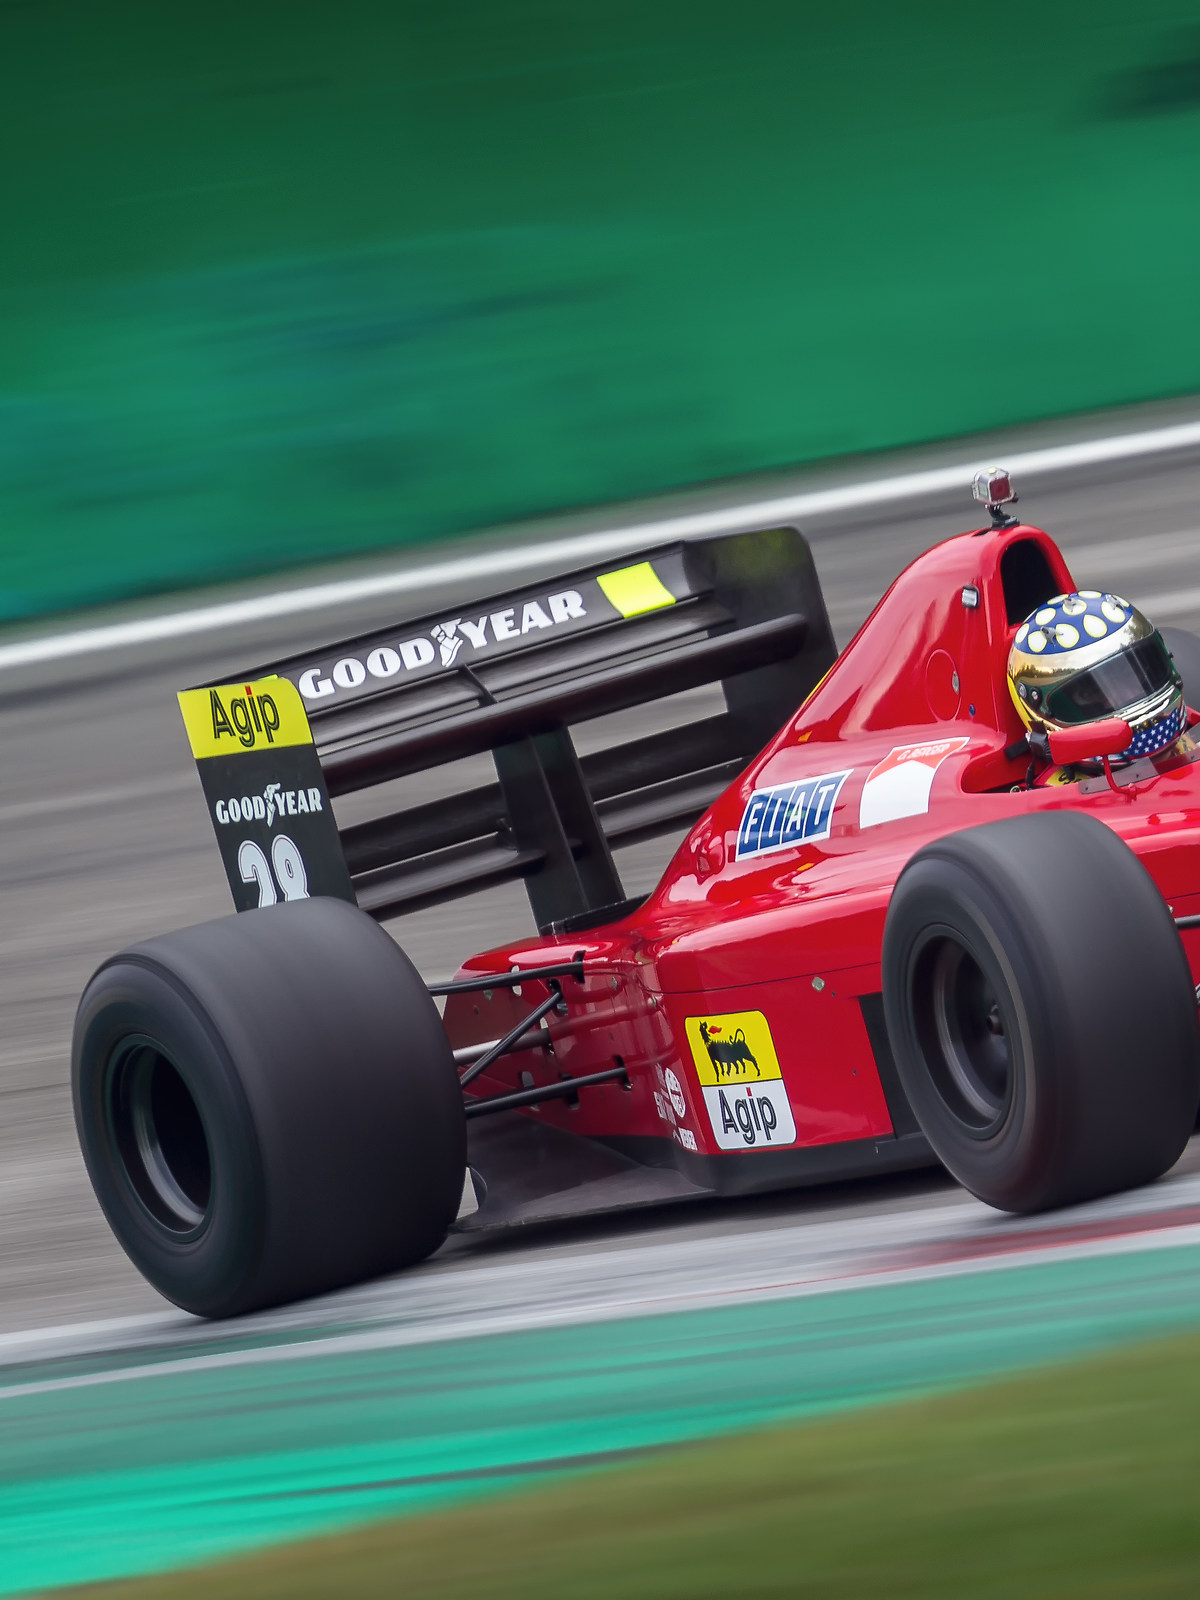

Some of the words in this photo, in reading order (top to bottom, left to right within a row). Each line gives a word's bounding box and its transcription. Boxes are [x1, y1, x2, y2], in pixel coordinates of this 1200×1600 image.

[209, 686, 281, 748] Agip
[743, 778, 840, 845] FIAT
[238, 834, 311, 909] 28
[718, 1087, 779, 1146] Agip
